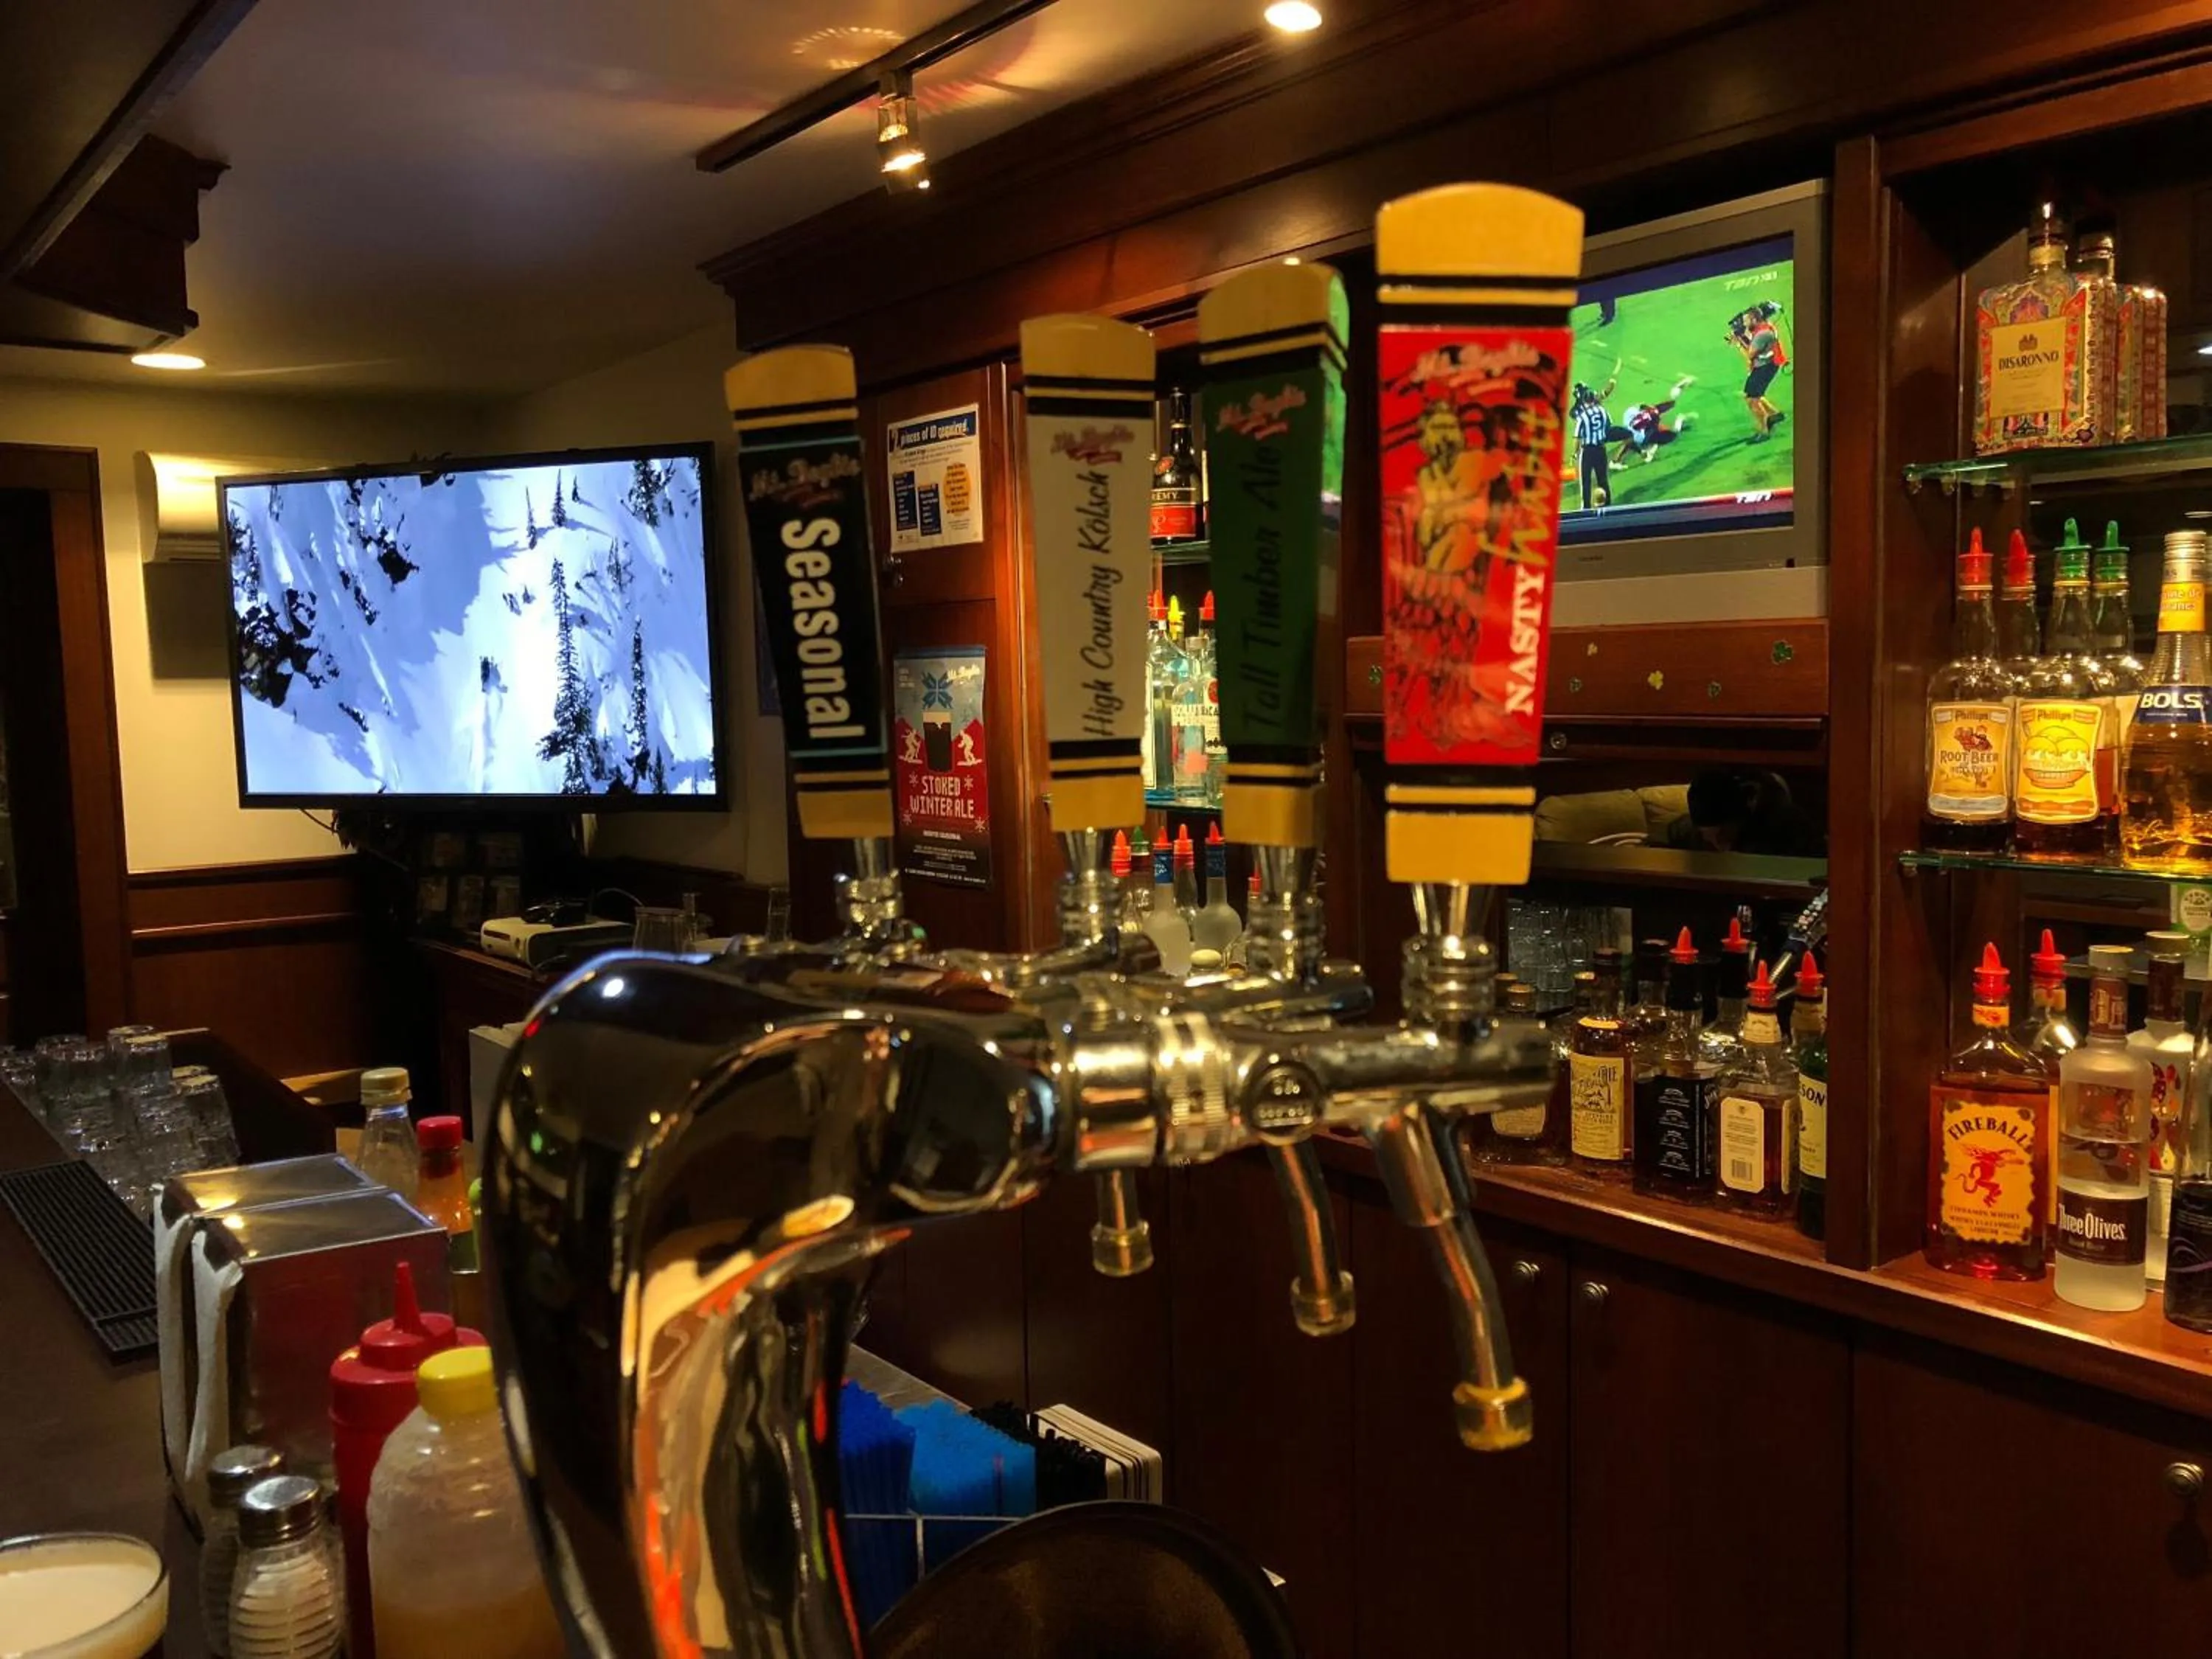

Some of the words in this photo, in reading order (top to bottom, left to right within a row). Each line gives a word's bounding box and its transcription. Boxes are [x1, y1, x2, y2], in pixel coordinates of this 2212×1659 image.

[1998, 351, 2059, 371] DISARONNO
[1240, 443, 1281, 511] Ale
[1076, 470, 1110, 554] Kölsch
[1240, 524, 1281, 648] Timber
[781, 518, 866, 738] Seasonal
[1080, 565, 1123, 669] Country
[1506, 565, 1545, 716] NASTY
[1082, 677, 1124, 736] High
[1238, 668, 1281, 730] Tall
[2140, 693, 2203, 709] BOLS
[922, 775, 961, 796] STOKED
[1940, 750, 1968, 762] ROOT
[1971, 751, 1999, 764] BEER
[909, 795, 952, 817] WINTER
[954, 799, 975, 818] ALE
[1947, 1117, 2028, 1146] FIREBALL
[2084, 1212, 2127, 1240] Olives
